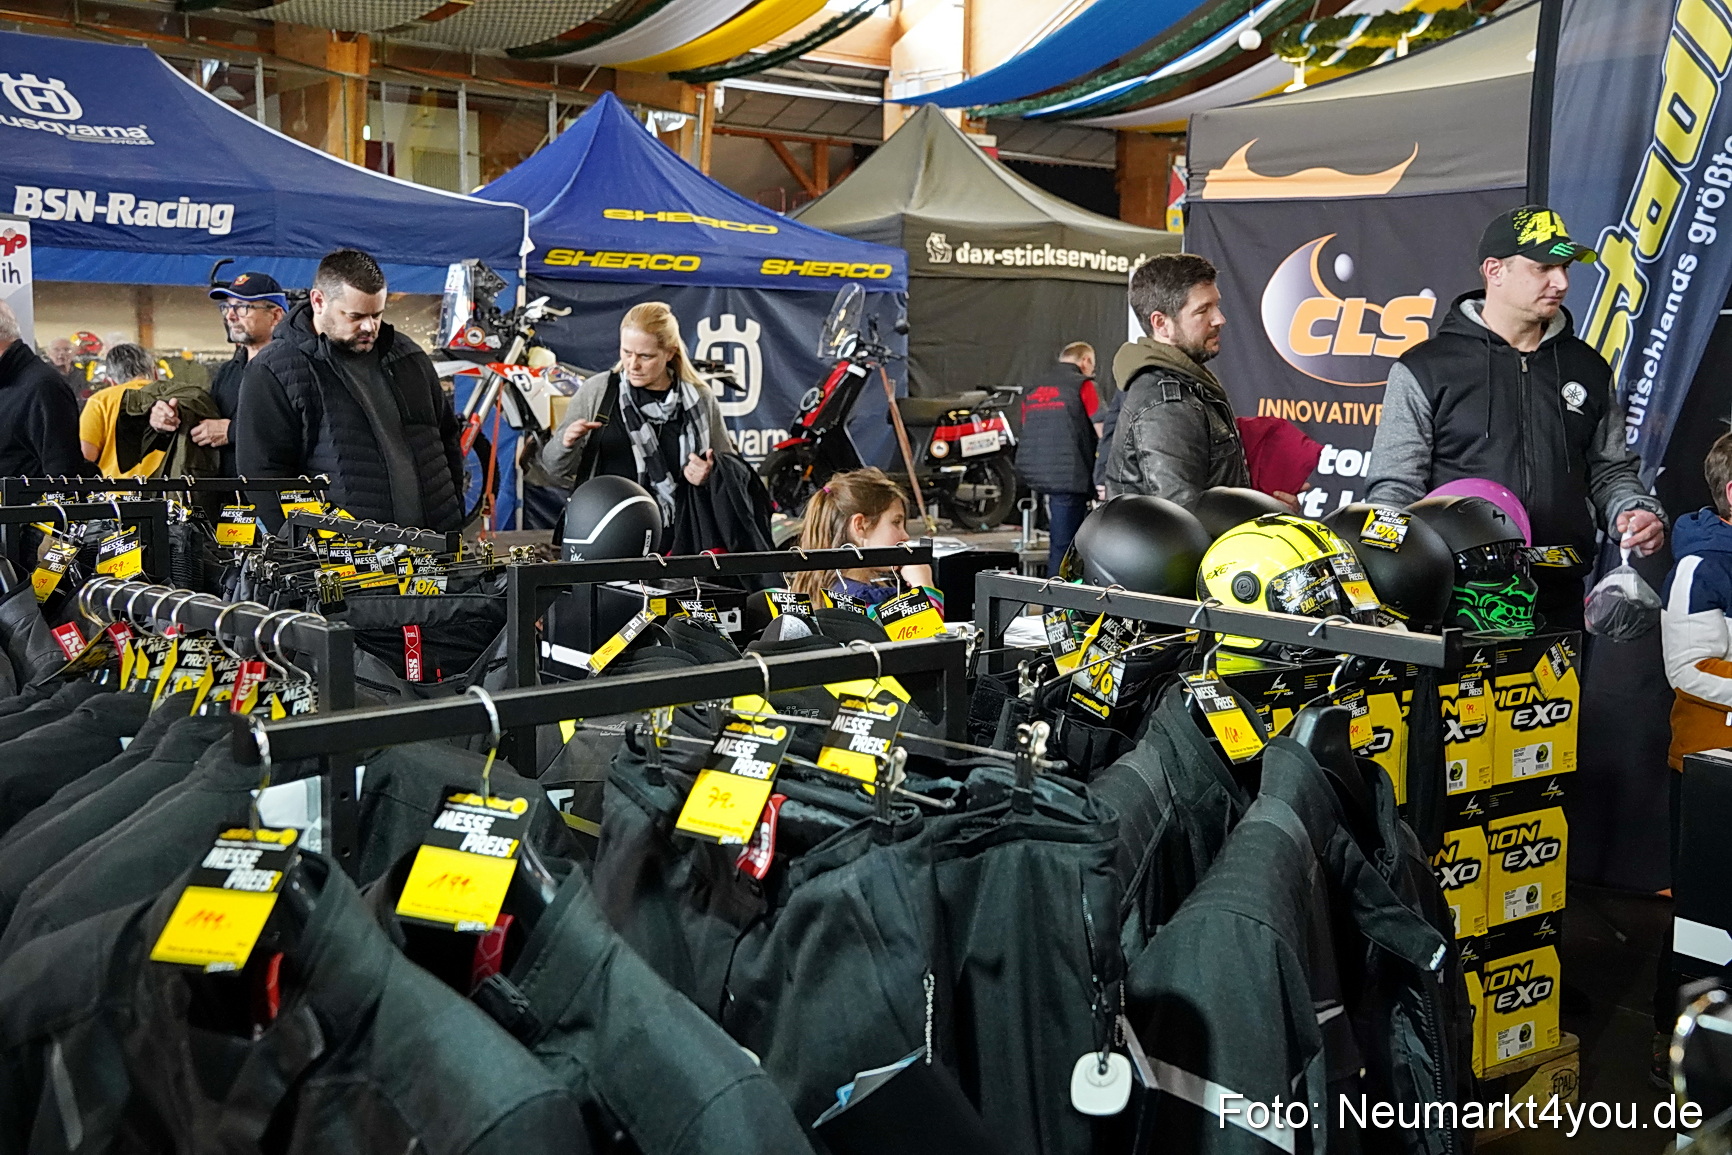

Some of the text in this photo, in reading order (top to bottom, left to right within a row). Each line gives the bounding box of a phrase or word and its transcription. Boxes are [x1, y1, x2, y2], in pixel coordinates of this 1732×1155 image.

[0, 114, 148, 138] usqvarna
[1580, 0, 1732, 392] Stadl
[14, 185, 235, 235] BSN-Racing
[603, 208, 779, 235] SHERCO
[543, 248, 702, 273] SHERCO
[760, 259, 893, 280] SHERCO
[1288, 296, 1437, 358] CLS
[1625, 252, 1700, 452] eutschlands
[100, 539, 126, 555] MESSE
[115, 540, 139, 556] PREIS!
[355, 556, 378, 566] MESSE
[772, 592, 797, 604] MESSE
[827, 590, 853, 604] MESSE
[881, 600, 910, 619] MESSE
[901, 601, 930, 617] PREIS!
[178, 638, 217, 652] MESSE
[1194, 685, 1220, 700] MESSE
[1213, 696, 1238, 711] PREIS!
[1495, 686, 1545, 709] ION
[1513, 701, 1572, 727] EXO
[831, 715, 874, 737] MESSE
[713, 737, 760, 759] MESSE
[849, 735, 891, 755] PREIS!
[730, 757, 777, 780] PREIS!
[433, 810, 495, 835] MESSE
[460, 832, 519, 858] PREIS!
[1488, 824, 1539, 851] ION
[201, 847, 263, 870] MESSE
[1504, 842, 1559, 868] EXO
[223, 868, 283, 892] PREIS!
[1434, 863, 1479, 889] XO
[1496, 981, 1551, 1009] EXO
